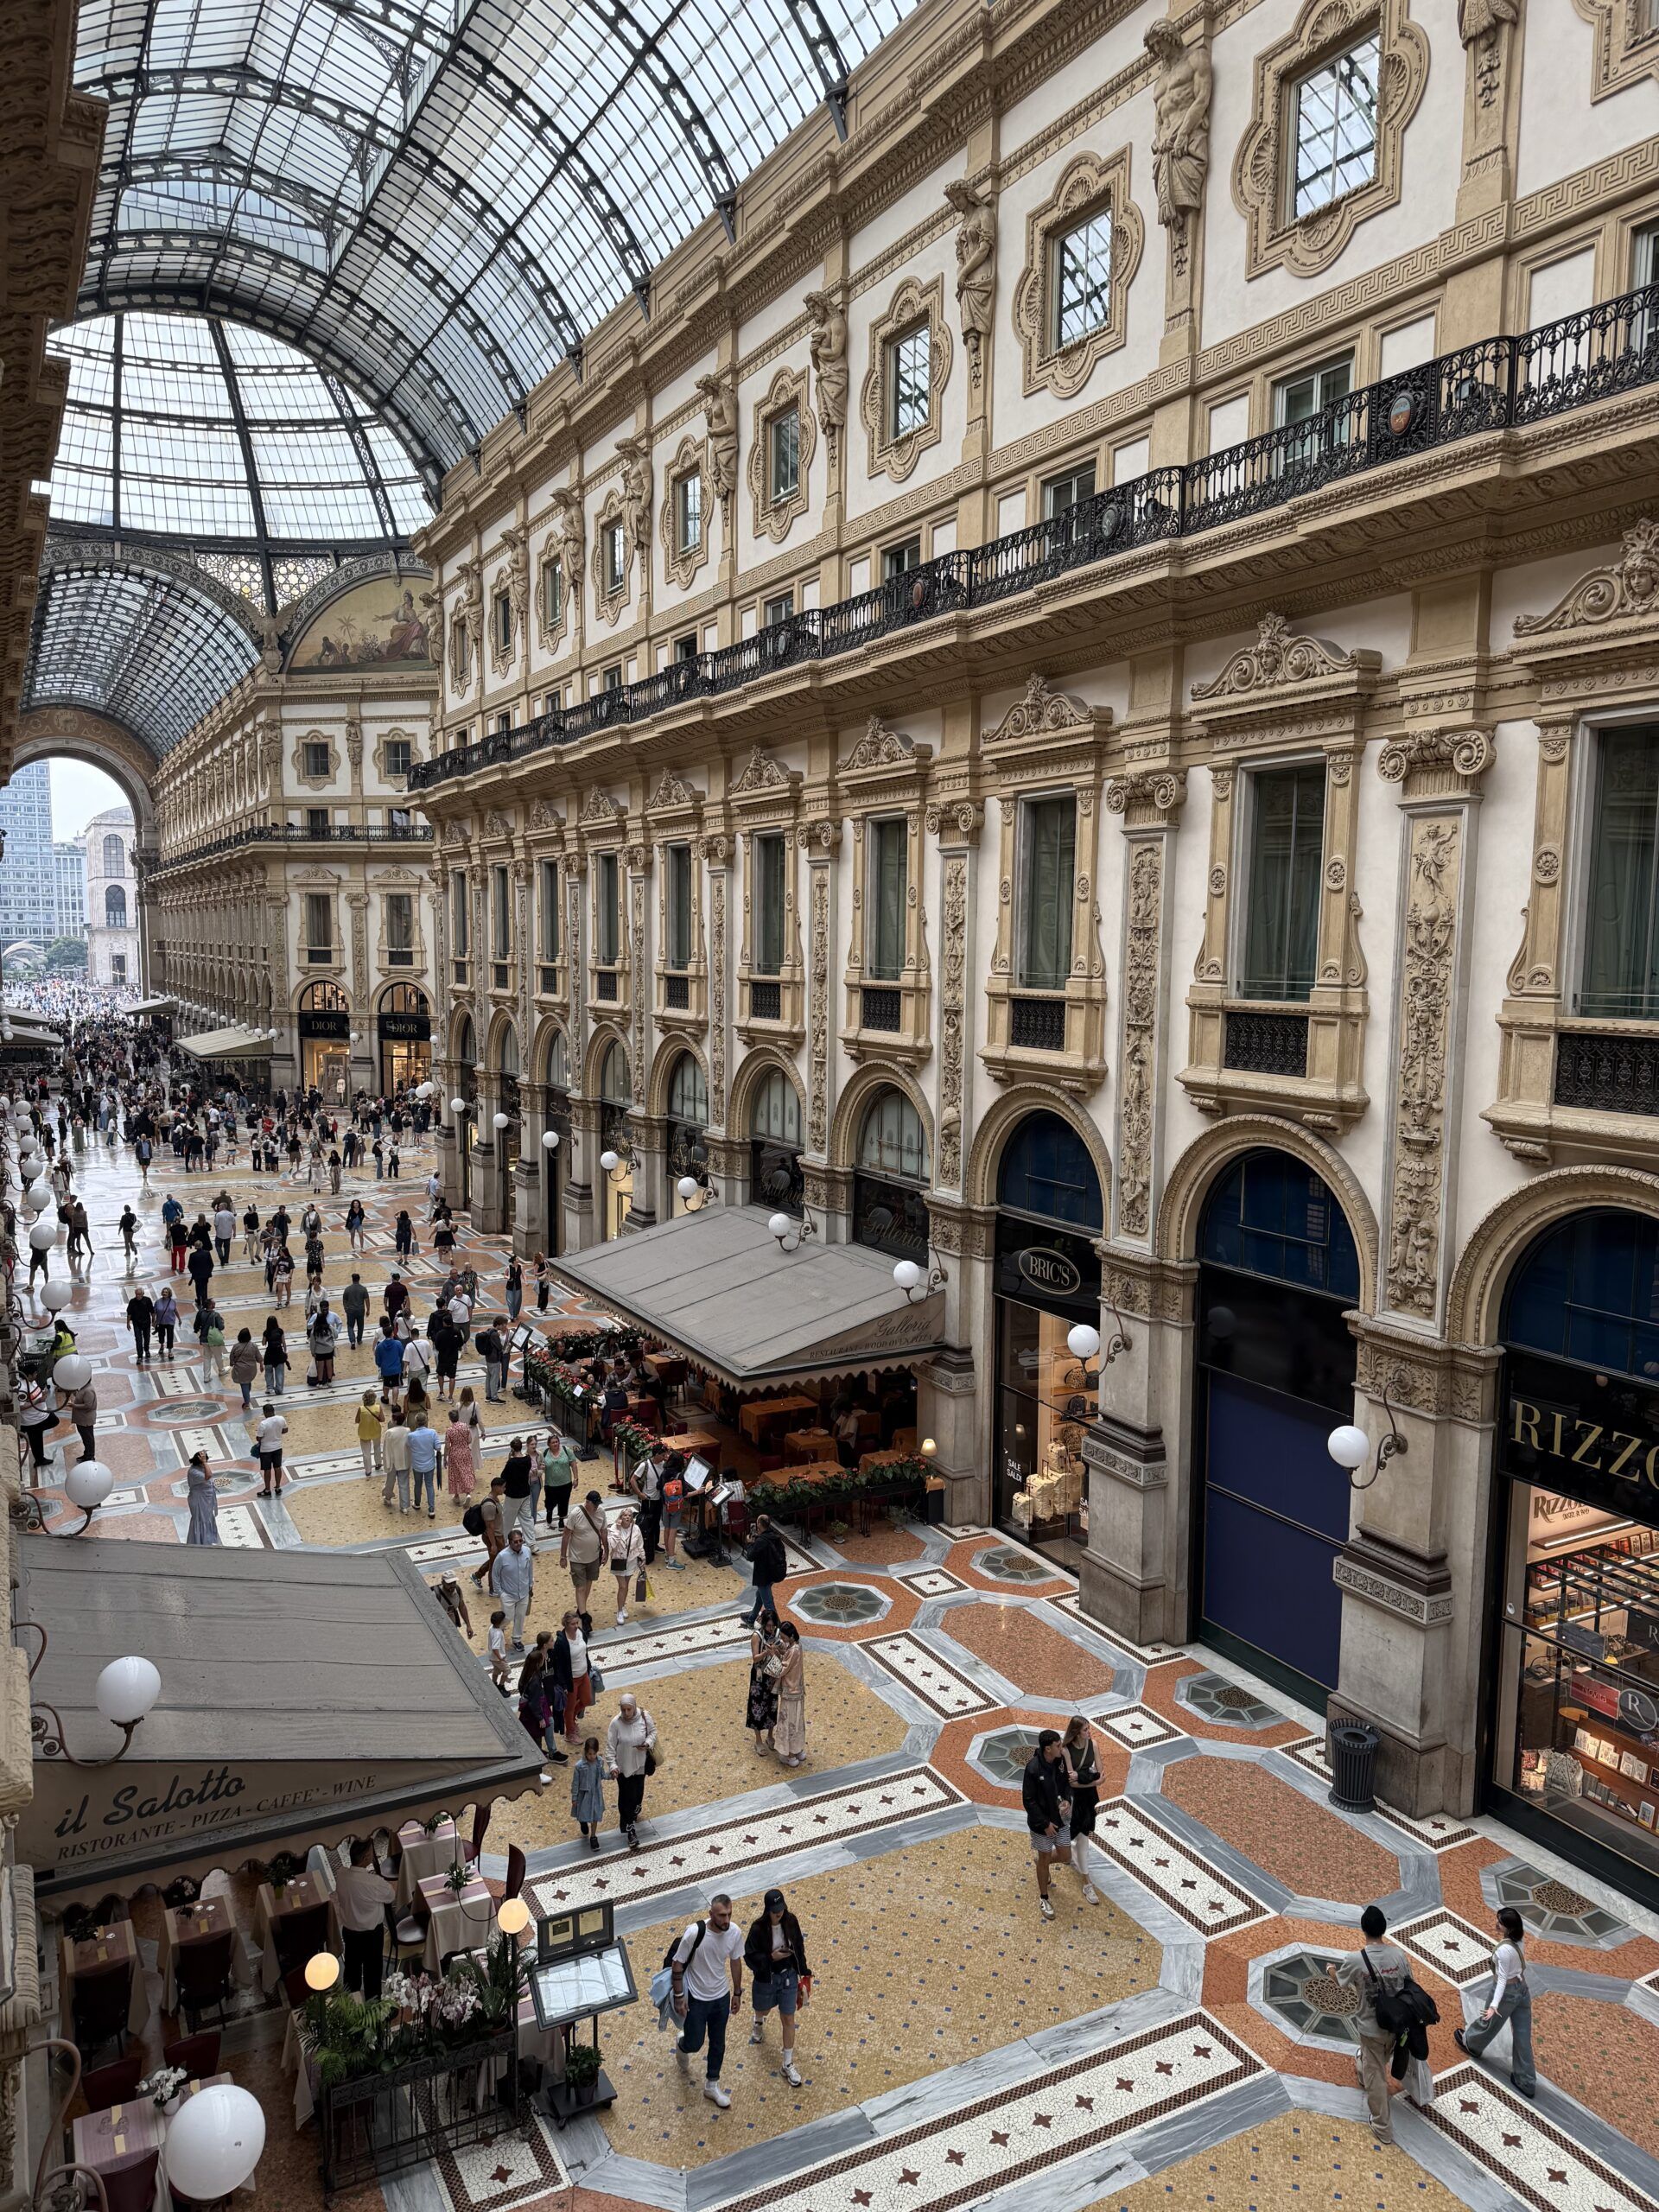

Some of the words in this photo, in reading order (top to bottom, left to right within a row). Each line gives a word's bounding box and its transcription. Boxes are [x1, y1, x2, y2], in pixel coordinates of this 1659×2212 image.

[312, 1020, 337, 1031] DIOR
[391, 1021, 417, 1033] DIOR
[863, 1203, 924, 1251] Galleria
[1029, 1255, 1071, 1287] BRIC'S
[874, 1314, 932, 1338] Galleria
[810, 1345, 858, 1359] RESTAURANT
[1007, 1459, 1021, 1471] SALE
[1007, 1468, 1022, 1483] SALDI
[1628, 1693, 1652, 1726] R
[54, 1794, 89, 1839] il
[103, 1765, 246, 1826] Salotto
[58, 1821, 176, 1860] RISTORANTE
[191, 1805, 242, 1828] PIZZA
[333, 1774, 377, 1796] WINE
